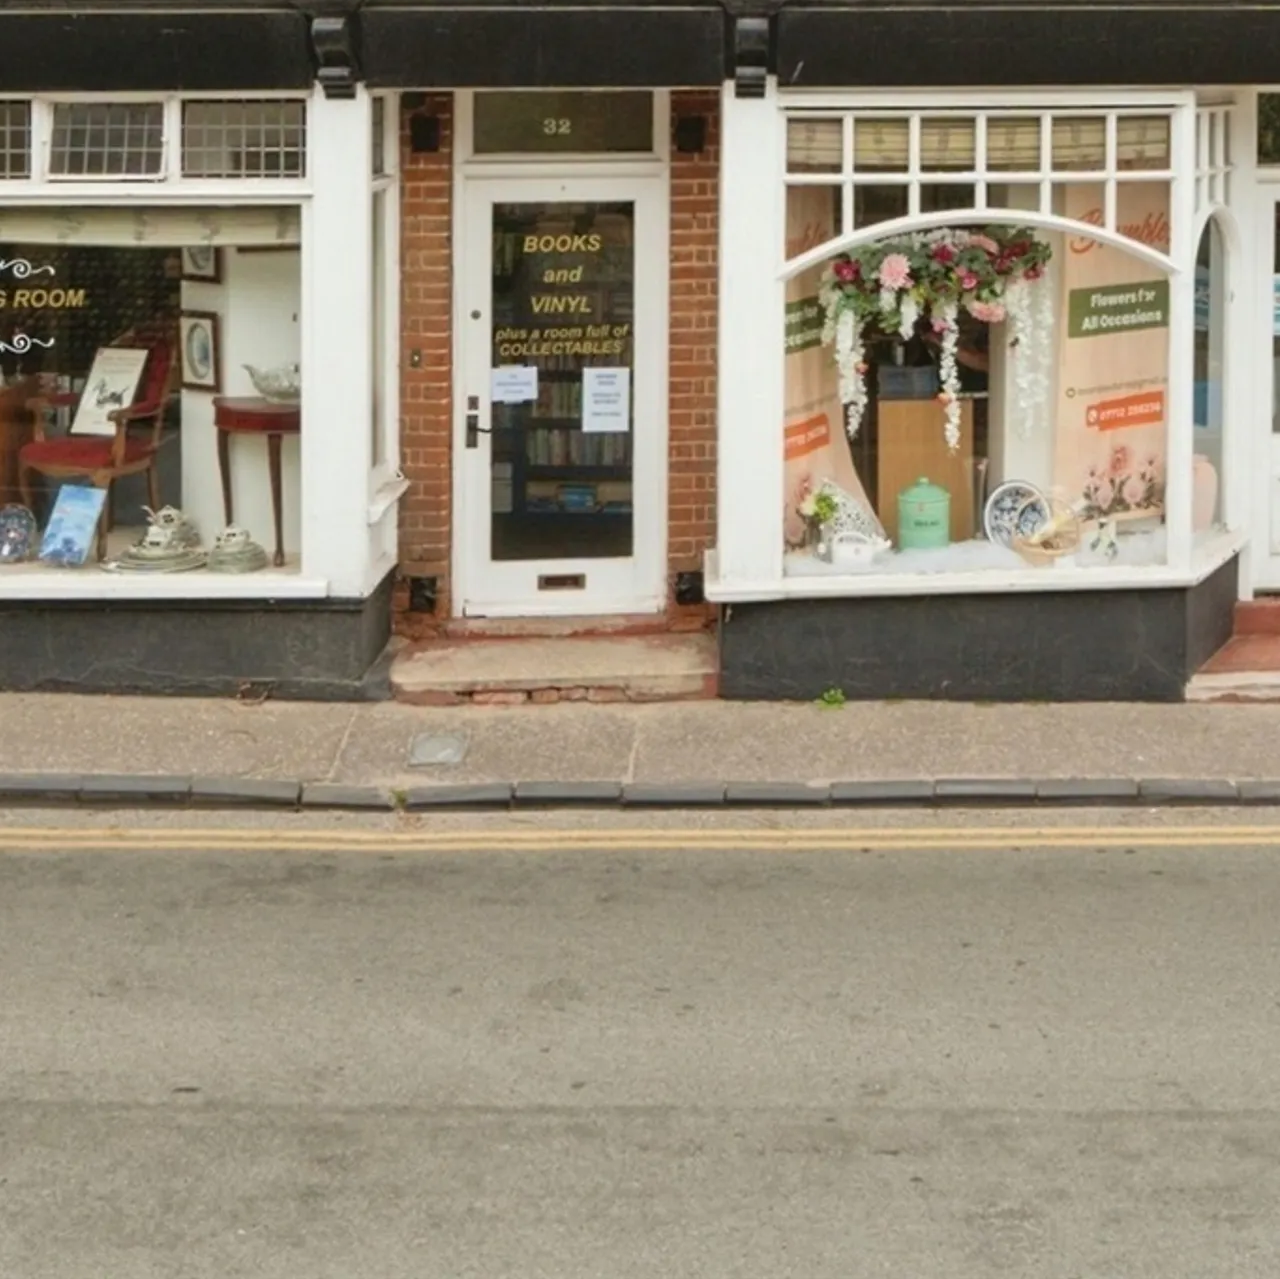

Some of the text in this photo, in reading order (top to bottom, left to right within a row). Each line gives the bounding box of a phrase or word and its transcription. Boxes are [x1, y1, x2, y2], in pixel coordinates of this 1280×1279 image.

[543, 117, 572, 136] 32
[523, 234, 601, 253] BOOKS
[543, 265, 583, 284] and
[13, 289, 86, 308] ROOM
[531, 295, 592, 313] VINYL
[1081, 308, 1163, 331] All Occasions
[495, 322, 630, 342] plus a room full of
[500, 340, 624, 357] COLLECTABLES
